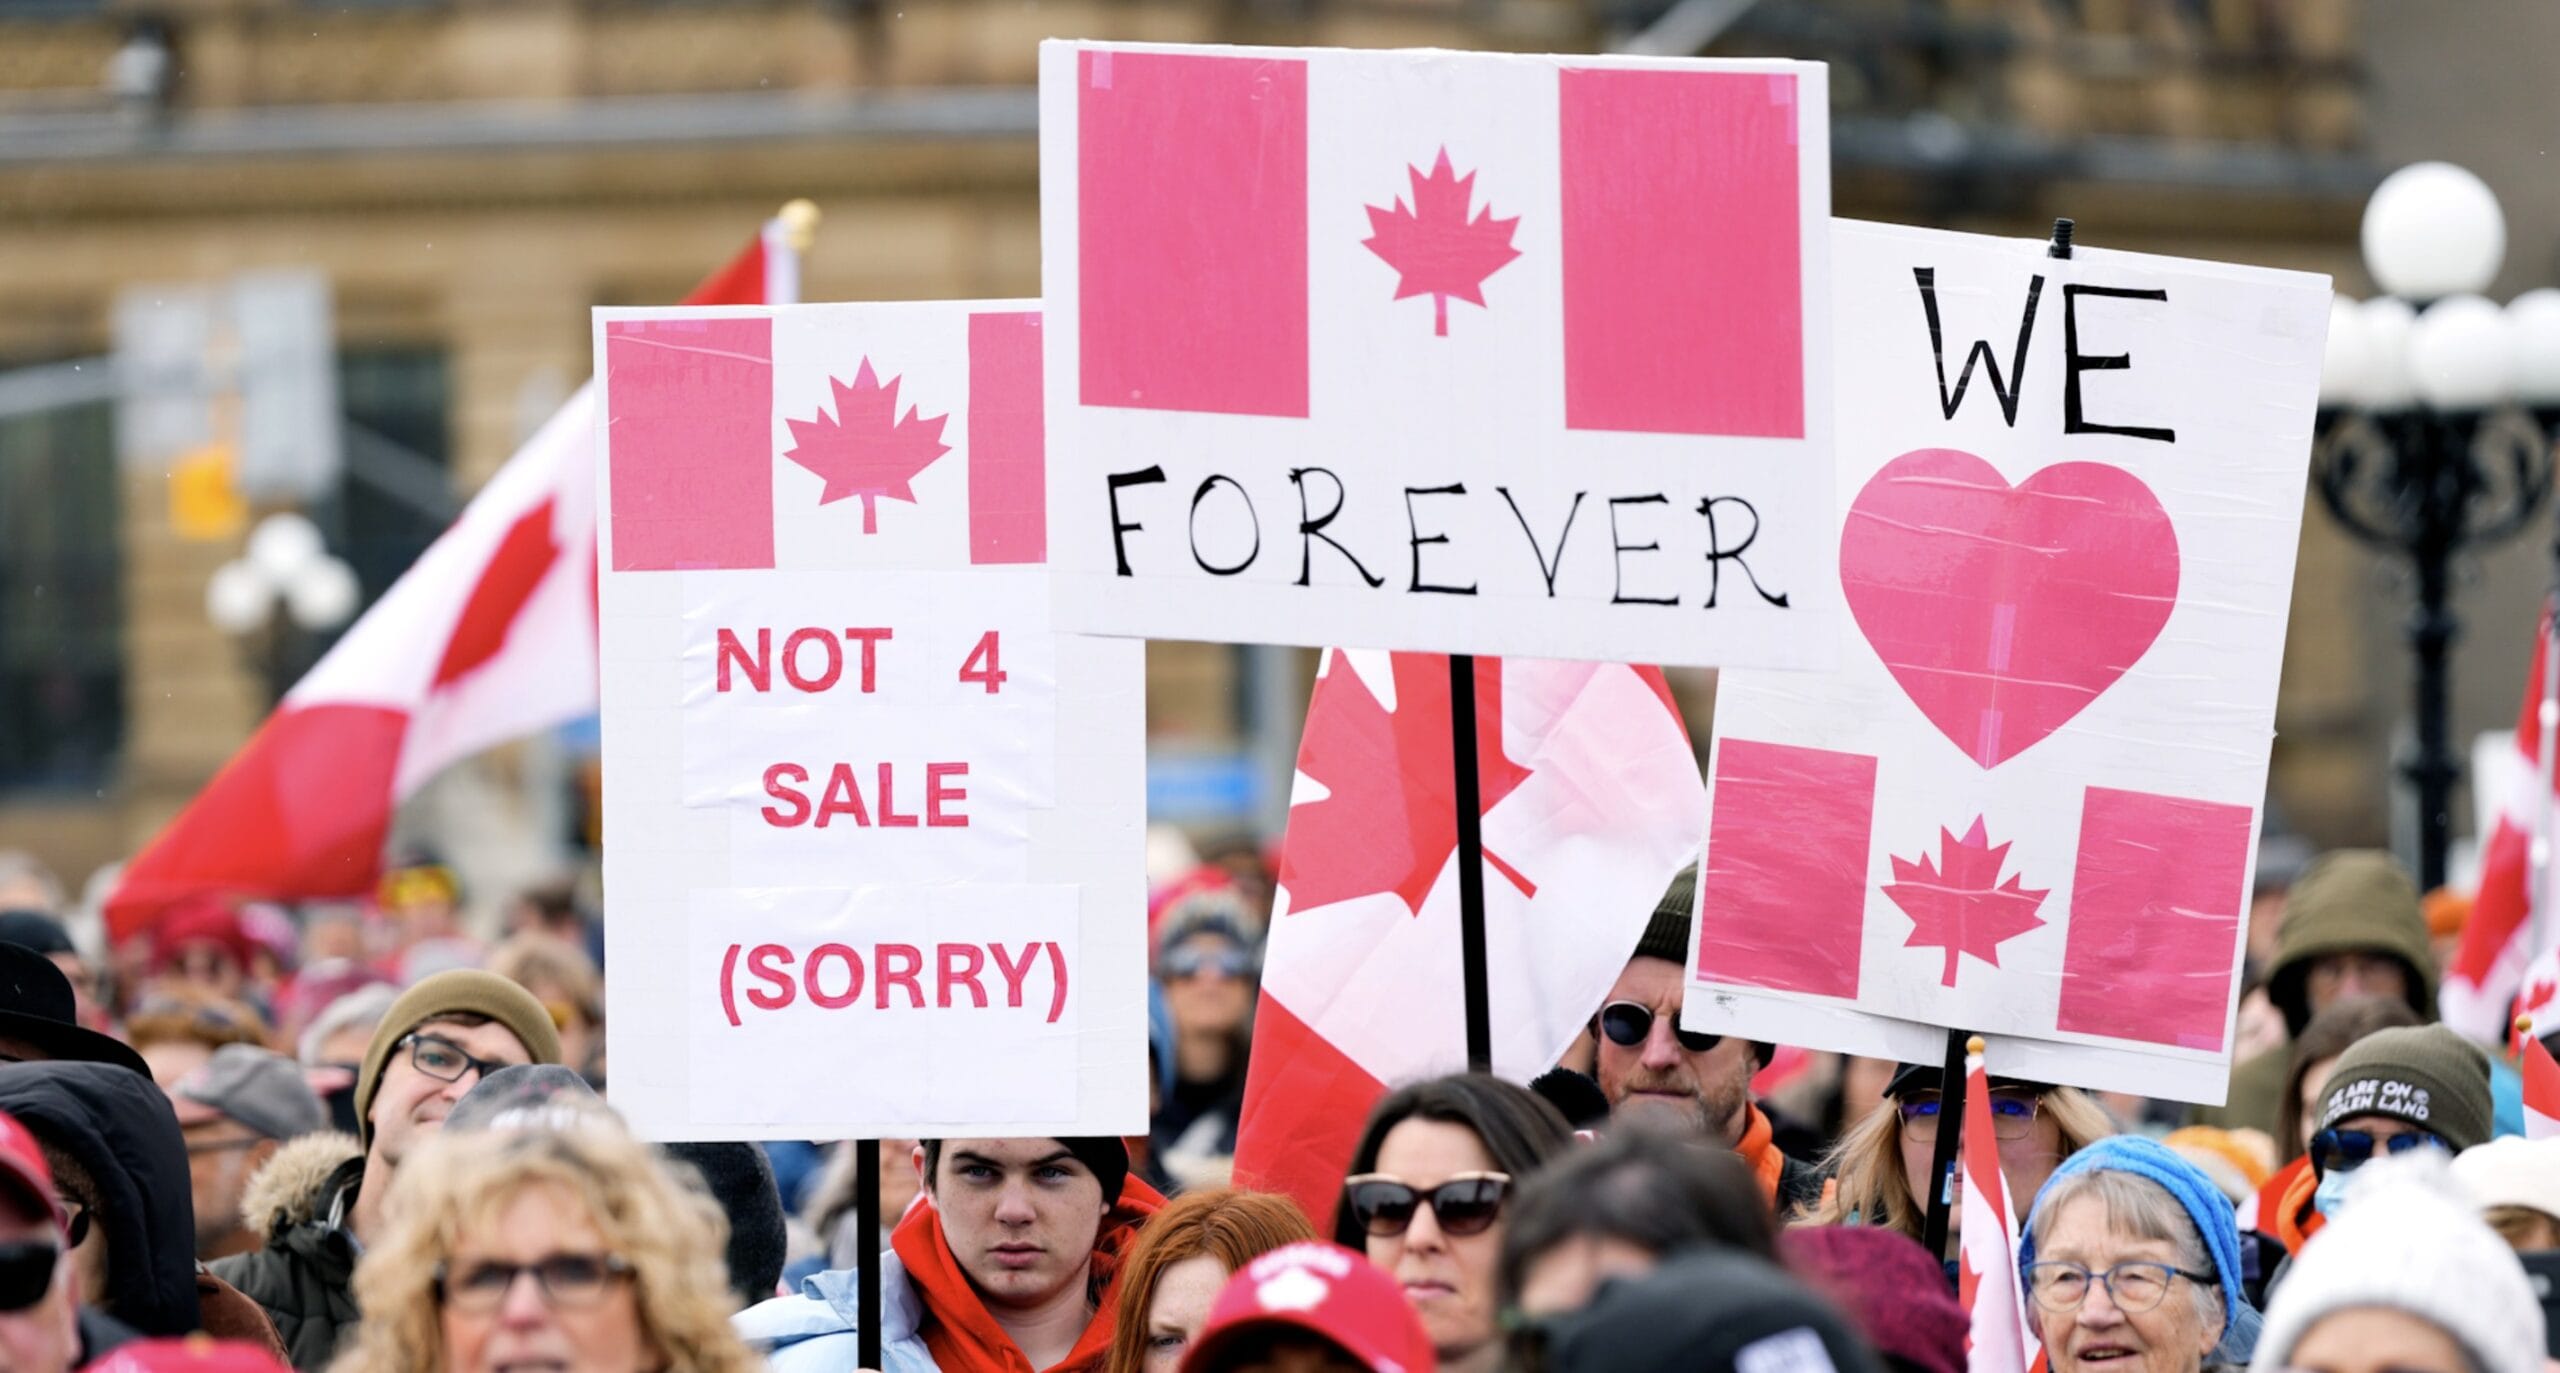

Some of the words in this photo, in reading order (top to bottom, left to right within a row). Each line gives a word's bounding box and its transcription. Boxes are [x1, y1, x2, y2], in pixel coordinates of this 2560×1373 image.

[1912, 266, 2177, 445] WE
[1106, 465, 1790, 610] FOREVER
[715, 627, 893, 695] NOT
[958, 630, 1008, 695] 4
[760, 762, 970, 829] SALE
[719, 941, 1069, 1028] (SORRY)
[2345, 1079, 2380, 1098] ARE
[2382, 1080, 2413, 1099] ON
[2377, 1094, 2430, 1121] LAND
